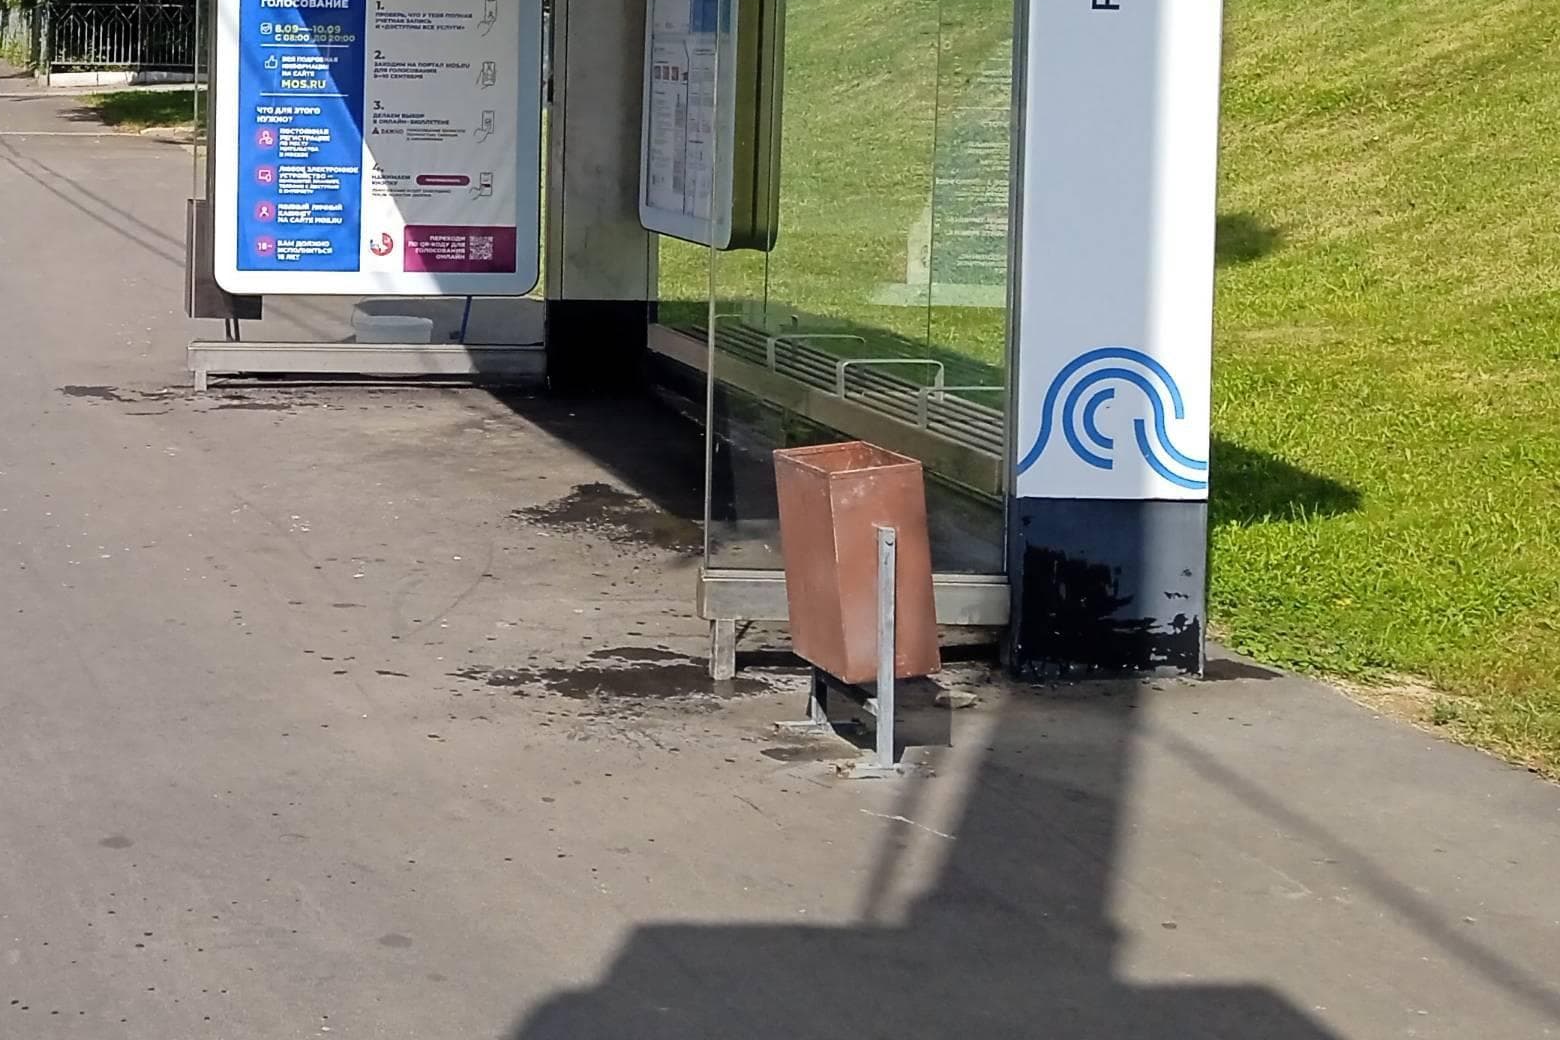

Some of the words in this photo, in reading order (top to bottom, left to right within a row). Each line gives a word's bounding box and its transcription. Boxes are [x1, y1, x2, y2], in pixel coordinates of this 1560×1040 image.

[375, 1, 384, 10] 1.
[275, 34, 282, 42] С
[283, 34, 310, 42] 08:00
[374, 50, 385, 60] 2.
[281, 80, 326, 89] MOS.RU
[373, 101, 384, 110] 3.
